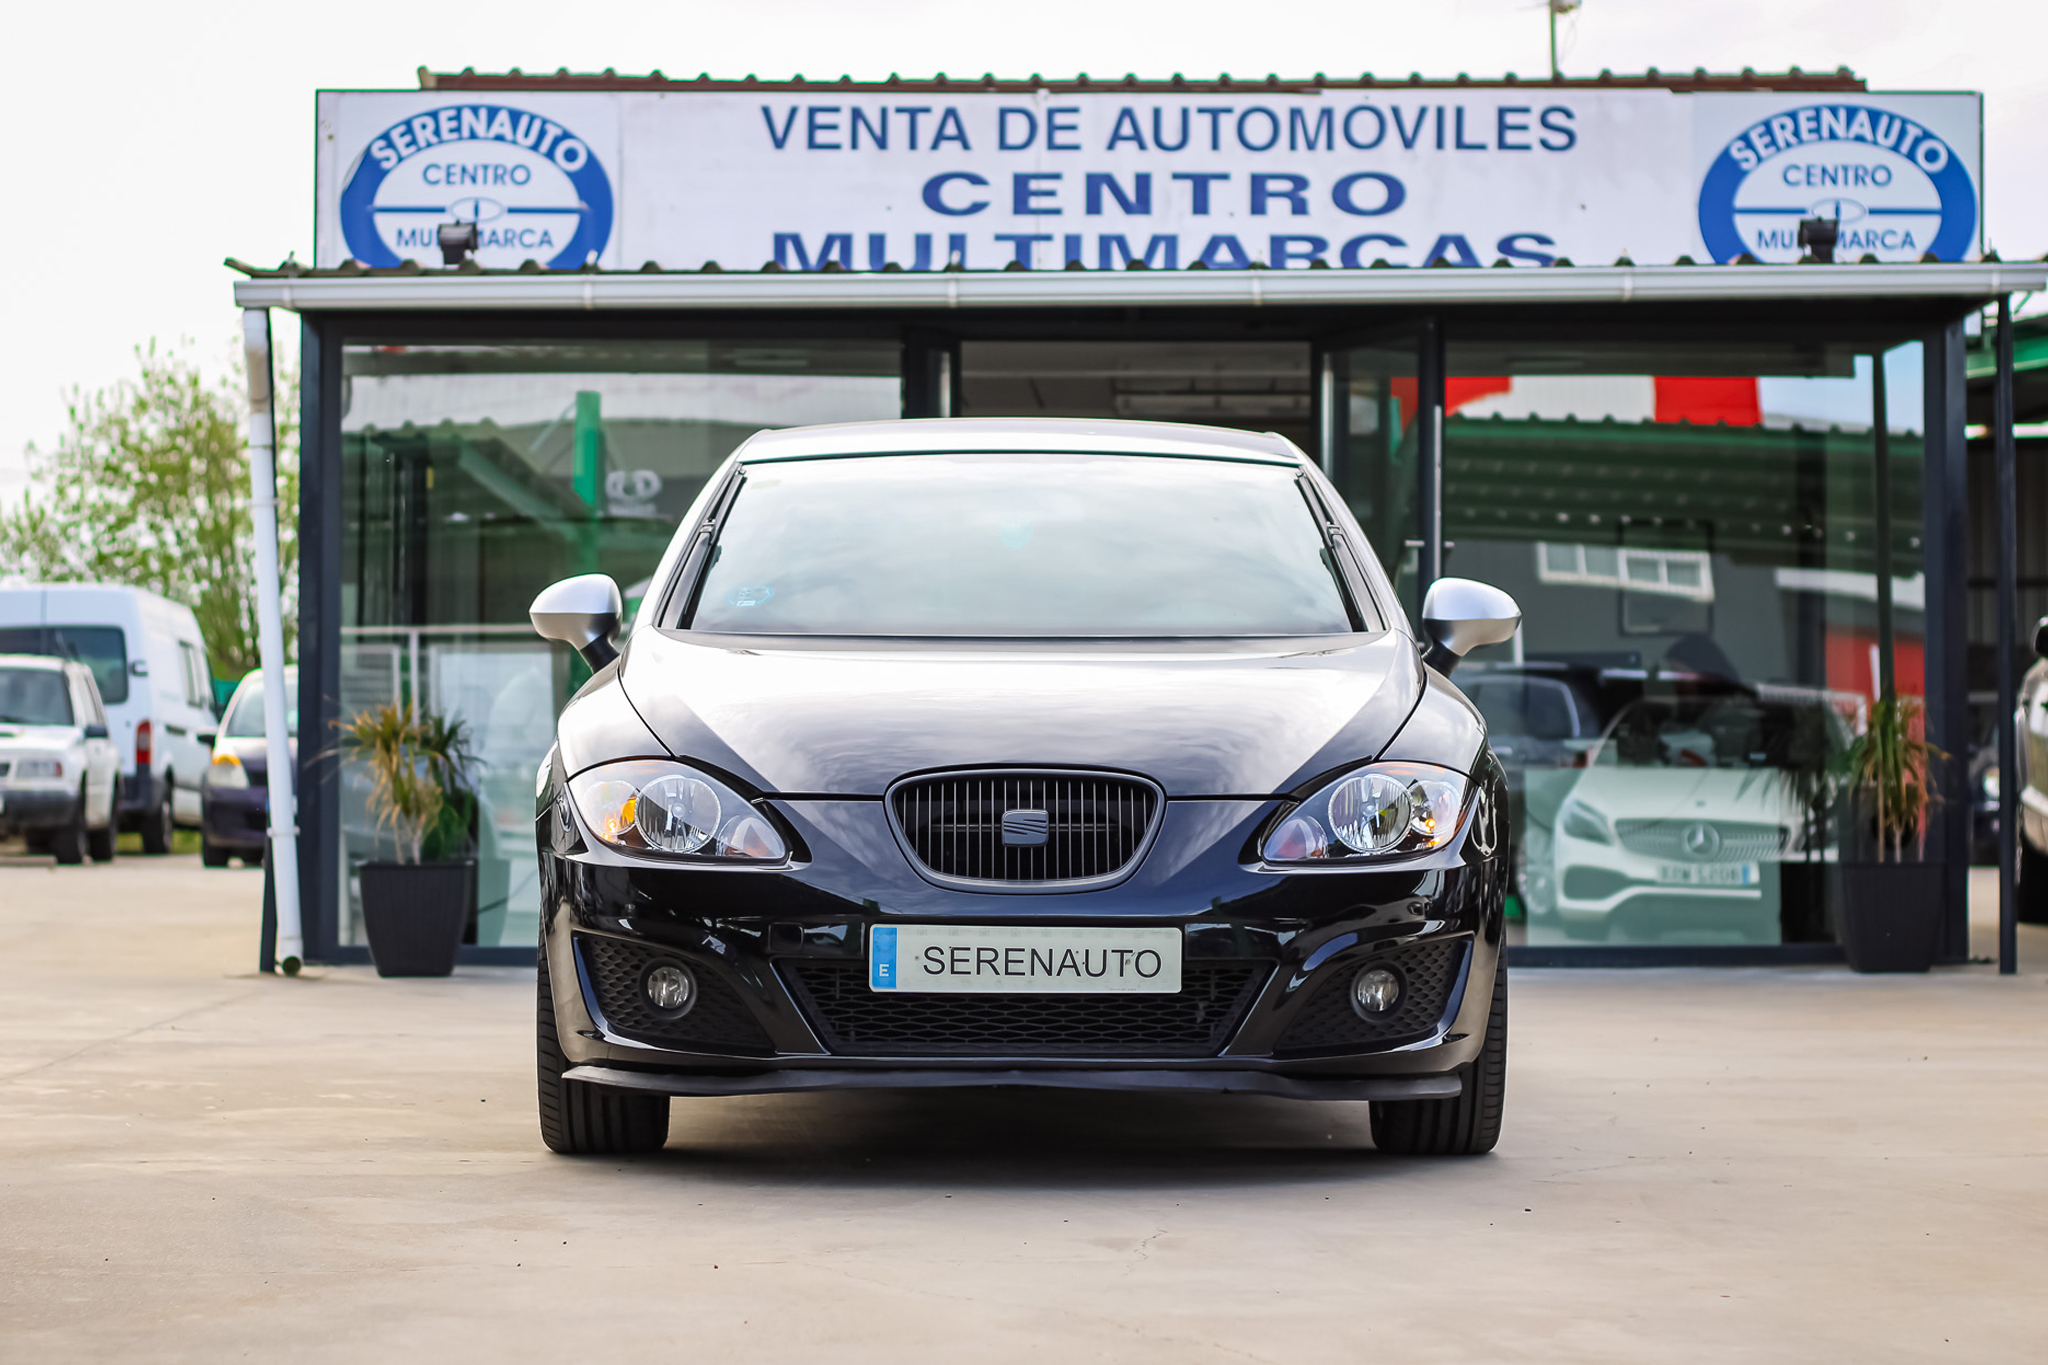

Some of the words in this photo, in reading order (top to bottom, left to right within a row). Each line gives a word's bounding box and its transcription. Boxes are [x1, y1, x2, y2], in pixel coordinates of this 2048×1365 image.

[371, 107, 588, 172] SERENAUTO
[762, 107, 972, 150] VENTA
[1000, 107, 1081, 150] DE
[1107, 106, 1577, 151] AUTOMOVILES
[1729, 106, 1949, 173] SERENAUTO
[423, 163, 531, 185] CENTRO
[1783, 164, 1892, 187] CENTRO
[922, 172, 1406, 216] CENTRO
[397, 229, 554, 248] MUARCA
[1758, 229, 1915, 249] MUARCA
[879, 964, 889, 977] E
[922, 946, 1162, 978] SERENAUTO
